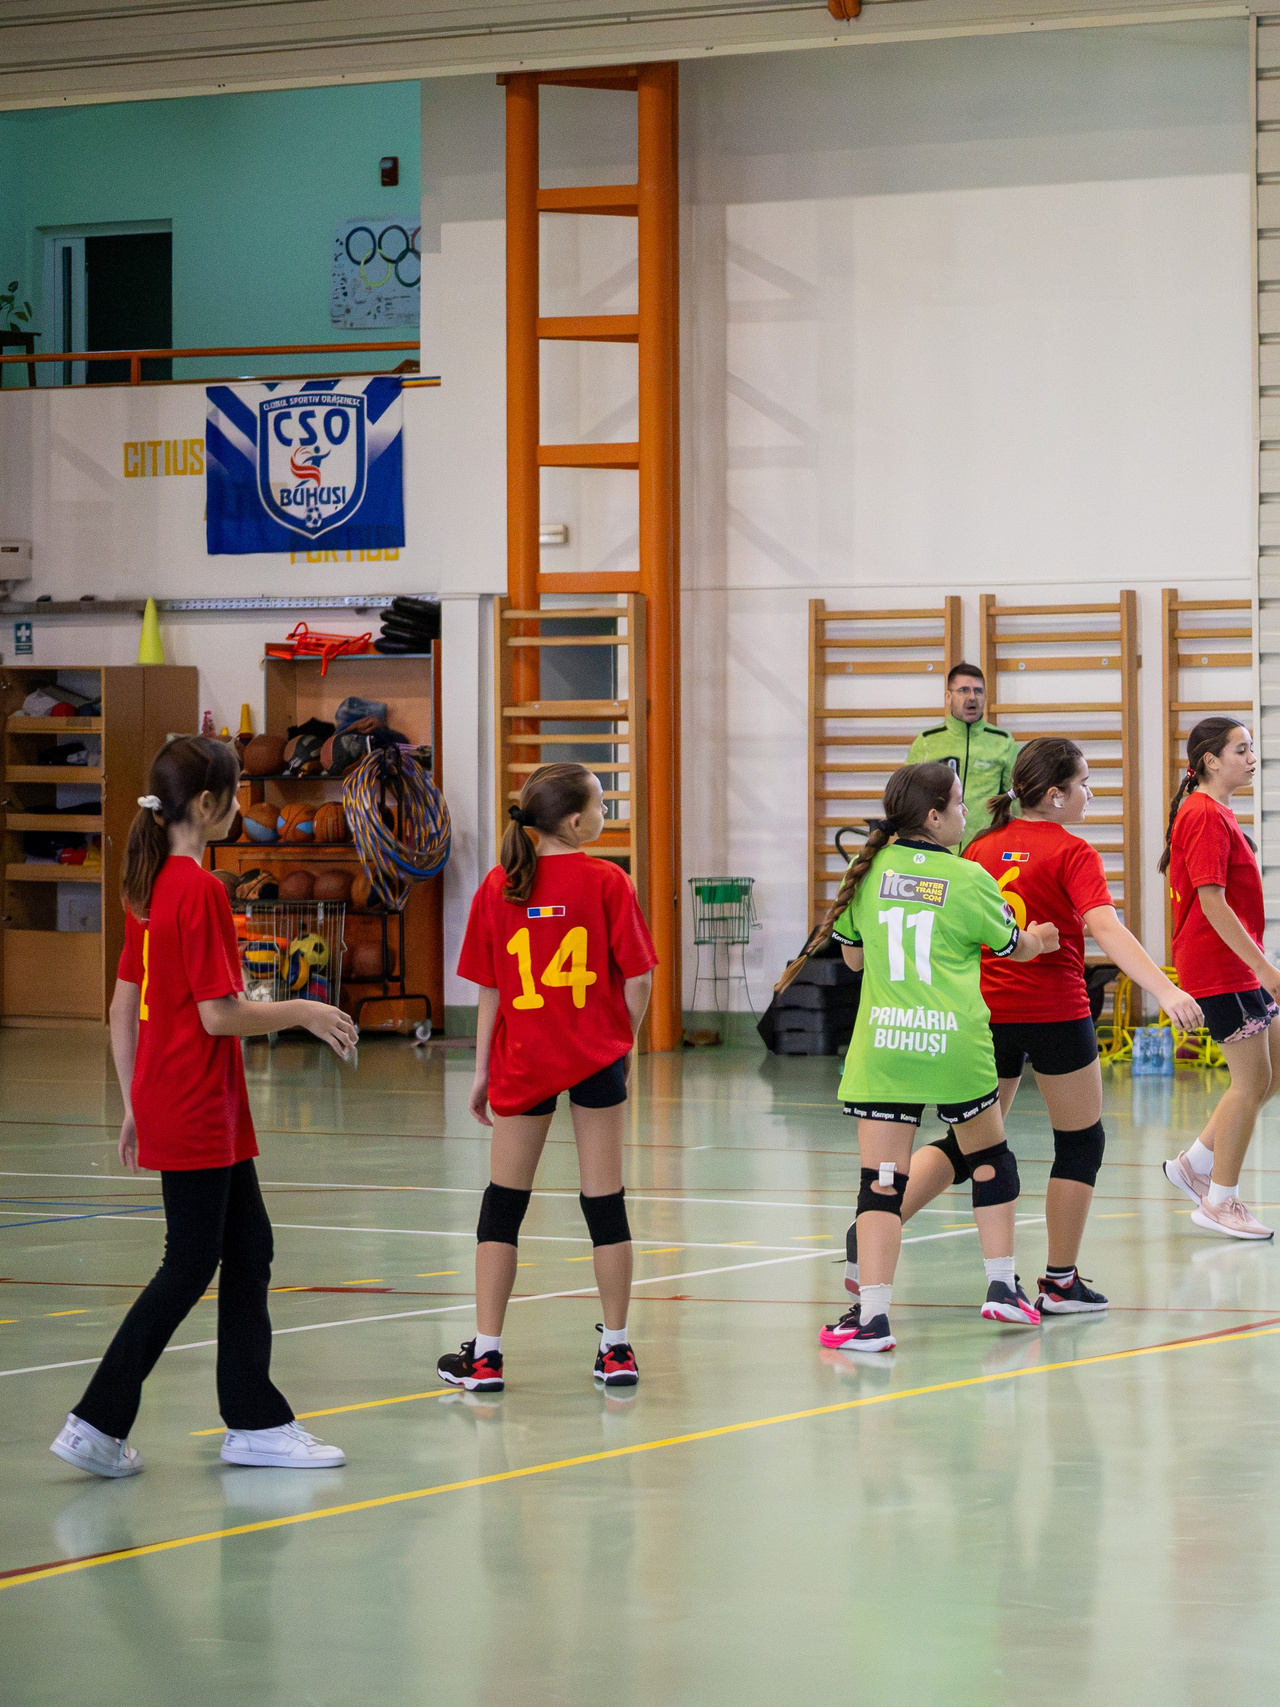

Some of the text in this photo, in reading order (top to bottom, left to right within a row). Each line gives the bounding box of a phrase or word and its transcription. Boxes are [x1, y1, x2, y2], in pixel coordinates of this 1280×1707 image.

[290, 395, 320, 406] SPORTIV
[273, 407, 350, 447] CSO
[123, 438, 205, 478] CITIUS
[915, 886, 943, 897] TRANS
[920, 880, 944, 890] INTER
[923, 893, 943, 903] COM
[878, 906, 936, 986] 11
[506, 926, 598, 1010] 14
[868, 1006, 958, 1032] PRIMĂRIA
[873, 1028, 947, 1057] BUHUȘI
[871, 1110, 895, 1121] Kempa
